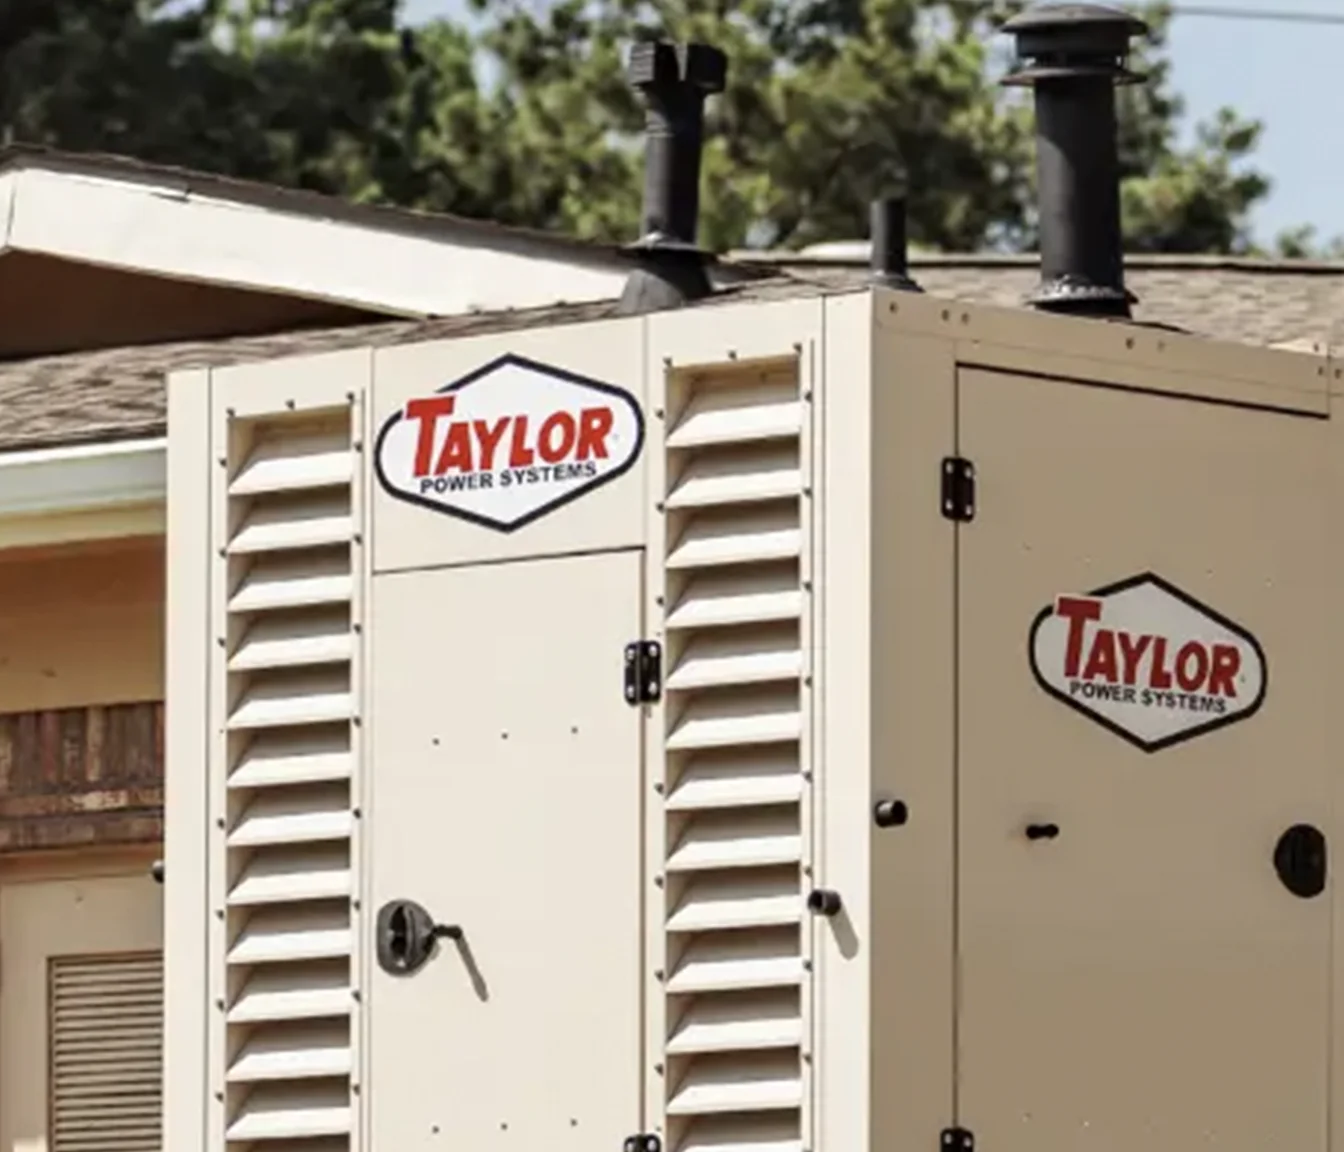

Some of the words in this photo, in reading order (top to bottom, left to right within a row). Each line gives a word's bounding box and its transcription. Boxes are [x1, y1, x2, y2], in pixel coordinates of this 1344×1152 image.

[405, 394, 614, 478] TAYLOR
[419, 472, 493, 494] POWER
[499, 461, 597, 487] SYSTEMS
[1057, 596, 1241, 698] TAYLOR
[1069, 681, 1137, 705] POWER
[1141, 689, 1227, 714] SYSTEMS
